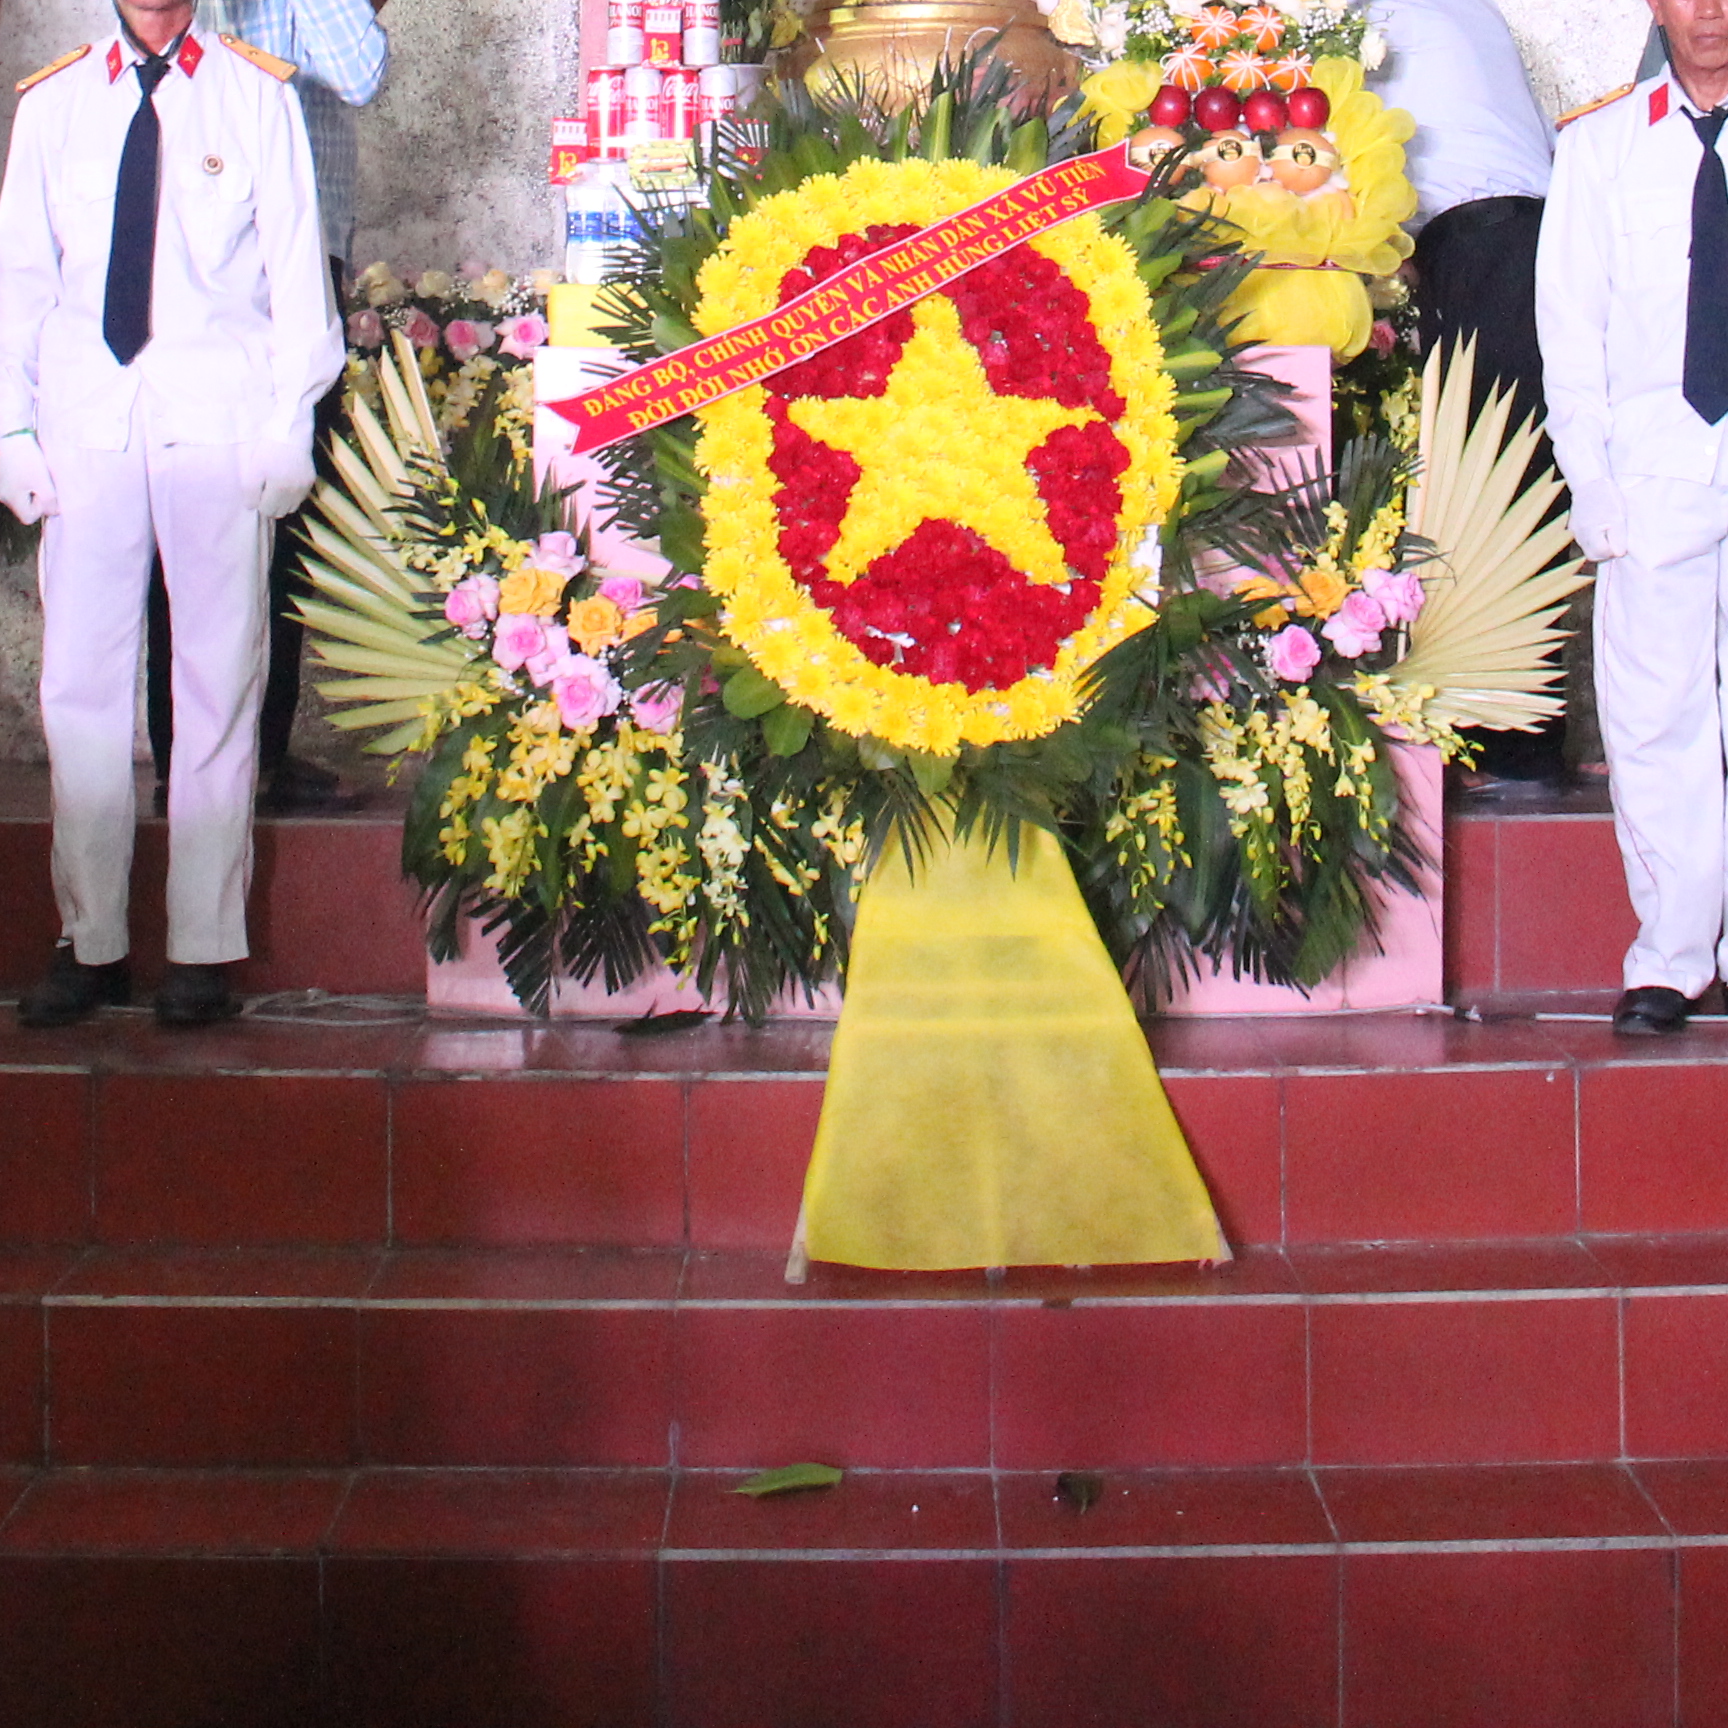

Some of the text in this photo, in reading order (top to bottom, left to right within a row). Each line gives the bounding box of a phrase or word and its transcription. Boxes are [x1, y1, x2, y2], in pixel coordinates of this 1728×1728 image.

[581, 375, 653, 418] ĐẢNG
[692, 325, 771, 370] CHÍNH
[771, 282, 850, 340] QUYỀN
[845, 261, 883, 294] VÀ
[878, 233, 942, 281] NHÂN
[937, 211, 988, 249] DÂN
[983, 193, 1025, 226] XÃ
[1018, 174, 1059, 205] VŨ
[1053, 159, 1107, 190] TIÊN
[626, 186, 1091, 430] ĐỜI ĐỜI NHỚ ƠN CÁC ANH HÙNG LIỆT SỸ
